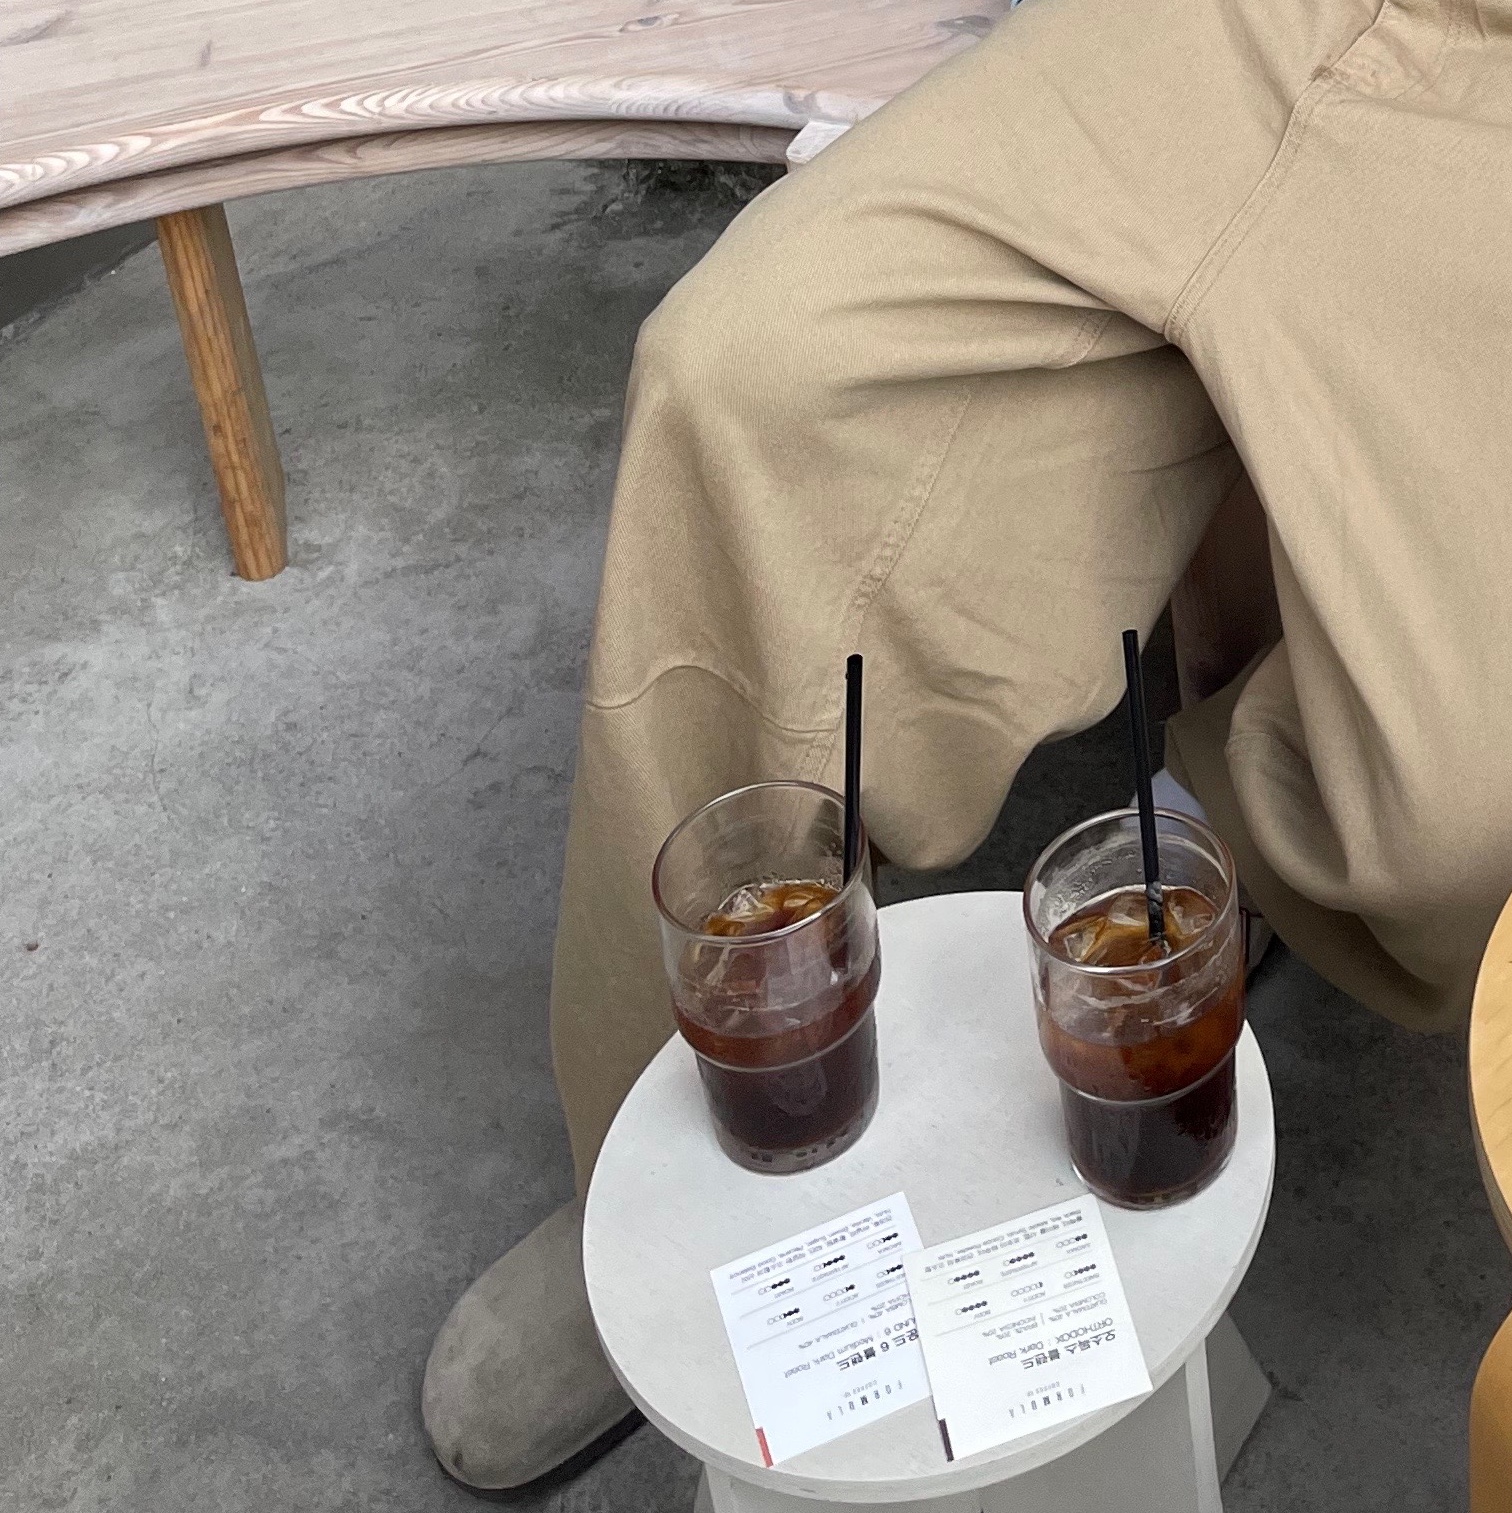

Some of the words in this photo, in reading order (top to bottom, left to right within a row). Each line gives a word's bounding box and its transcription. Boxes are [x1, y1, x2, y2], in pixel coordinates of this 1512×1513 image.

[891, 1327, 918, 1349] 운드
[1054, 1316, 1113, 1343] ORTHODOX
[836, 1333, 874, 1356] Medium
[879, 1339, 889, 1353] 6
[1018, 1339, 1044, 1355] Dark
[811, 1350, 834, 1366] Dark
[987, 1349, 1016, 1366] Roast
[783, 1360, 810, 1379] Roast
[825, 1379, 902, 1421] FORMULA
[1007, 1383, 1085, 1418] FORMULA
